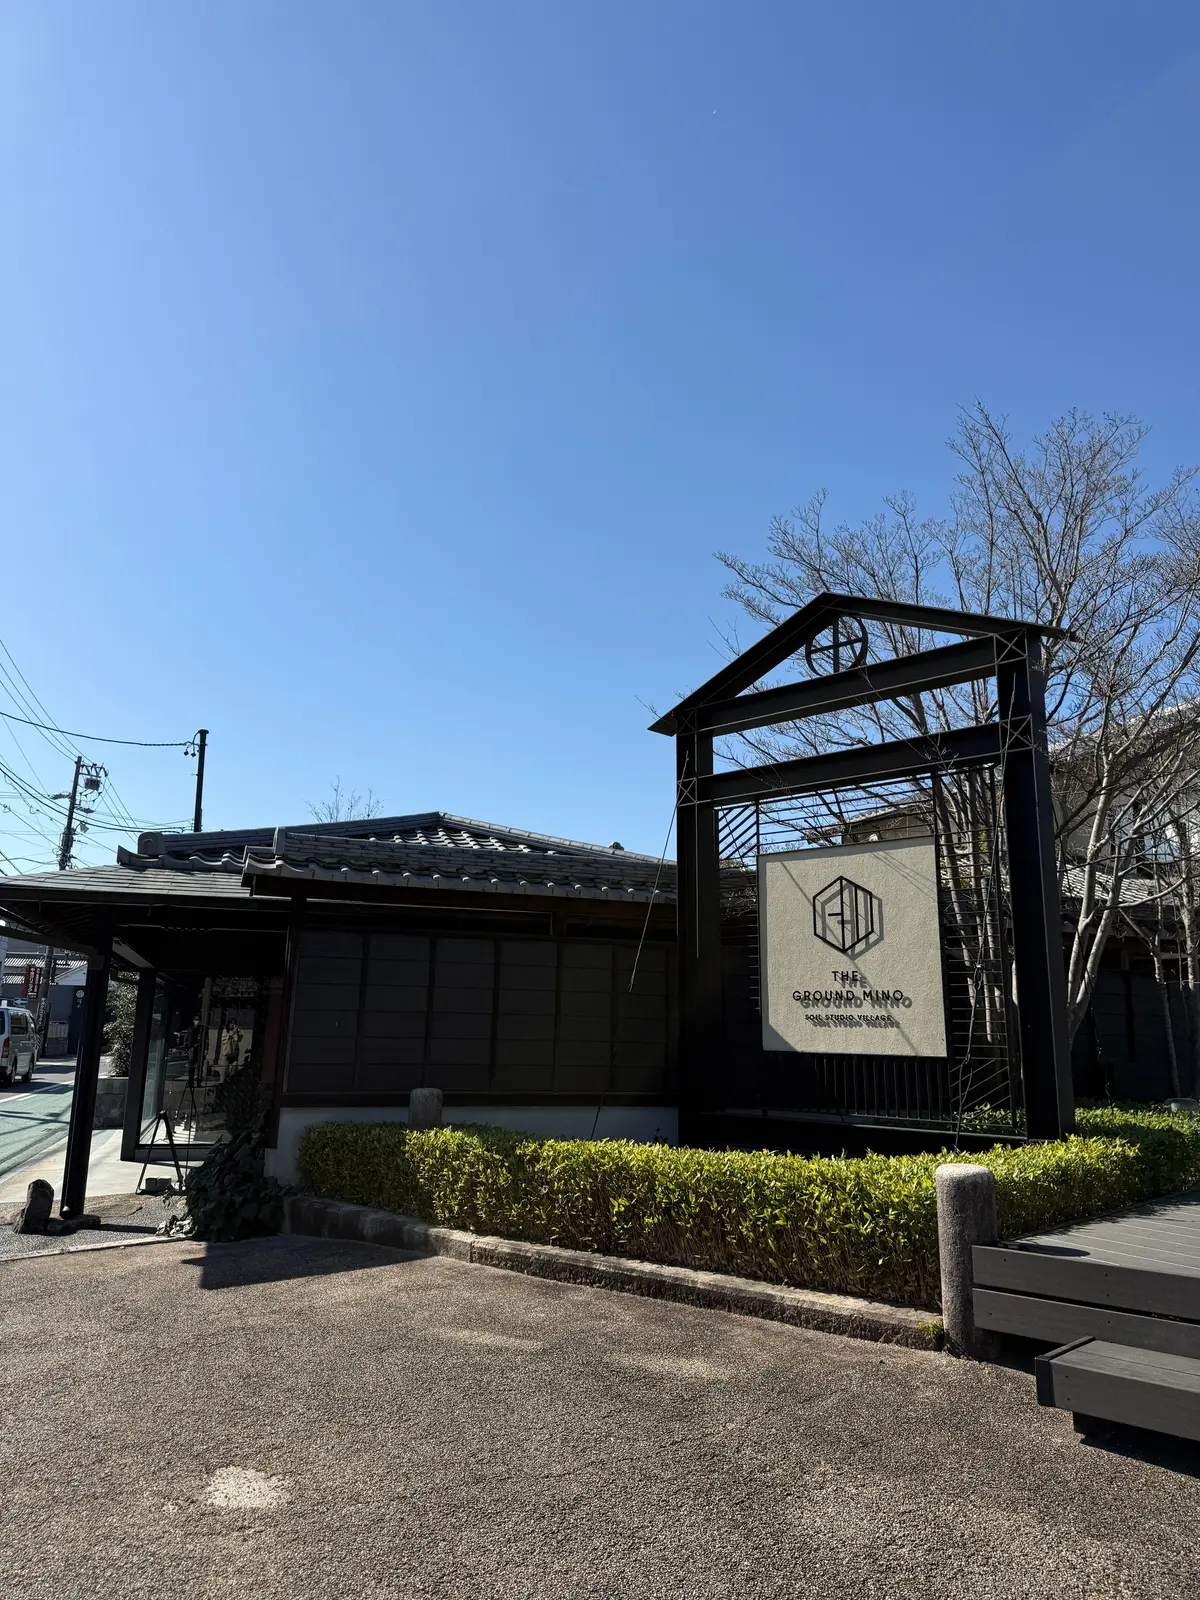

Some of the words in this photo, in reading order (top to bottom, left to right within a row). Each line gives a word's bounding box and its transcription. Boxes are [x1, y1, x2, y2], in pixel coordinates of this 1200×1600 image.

[831, 970, 860, 982] THE
[792, 990, 855, 1002] GROUND
[863, 989, 904, 1001] MINO
[857, 1014, 893, 1022] VILLAGE
